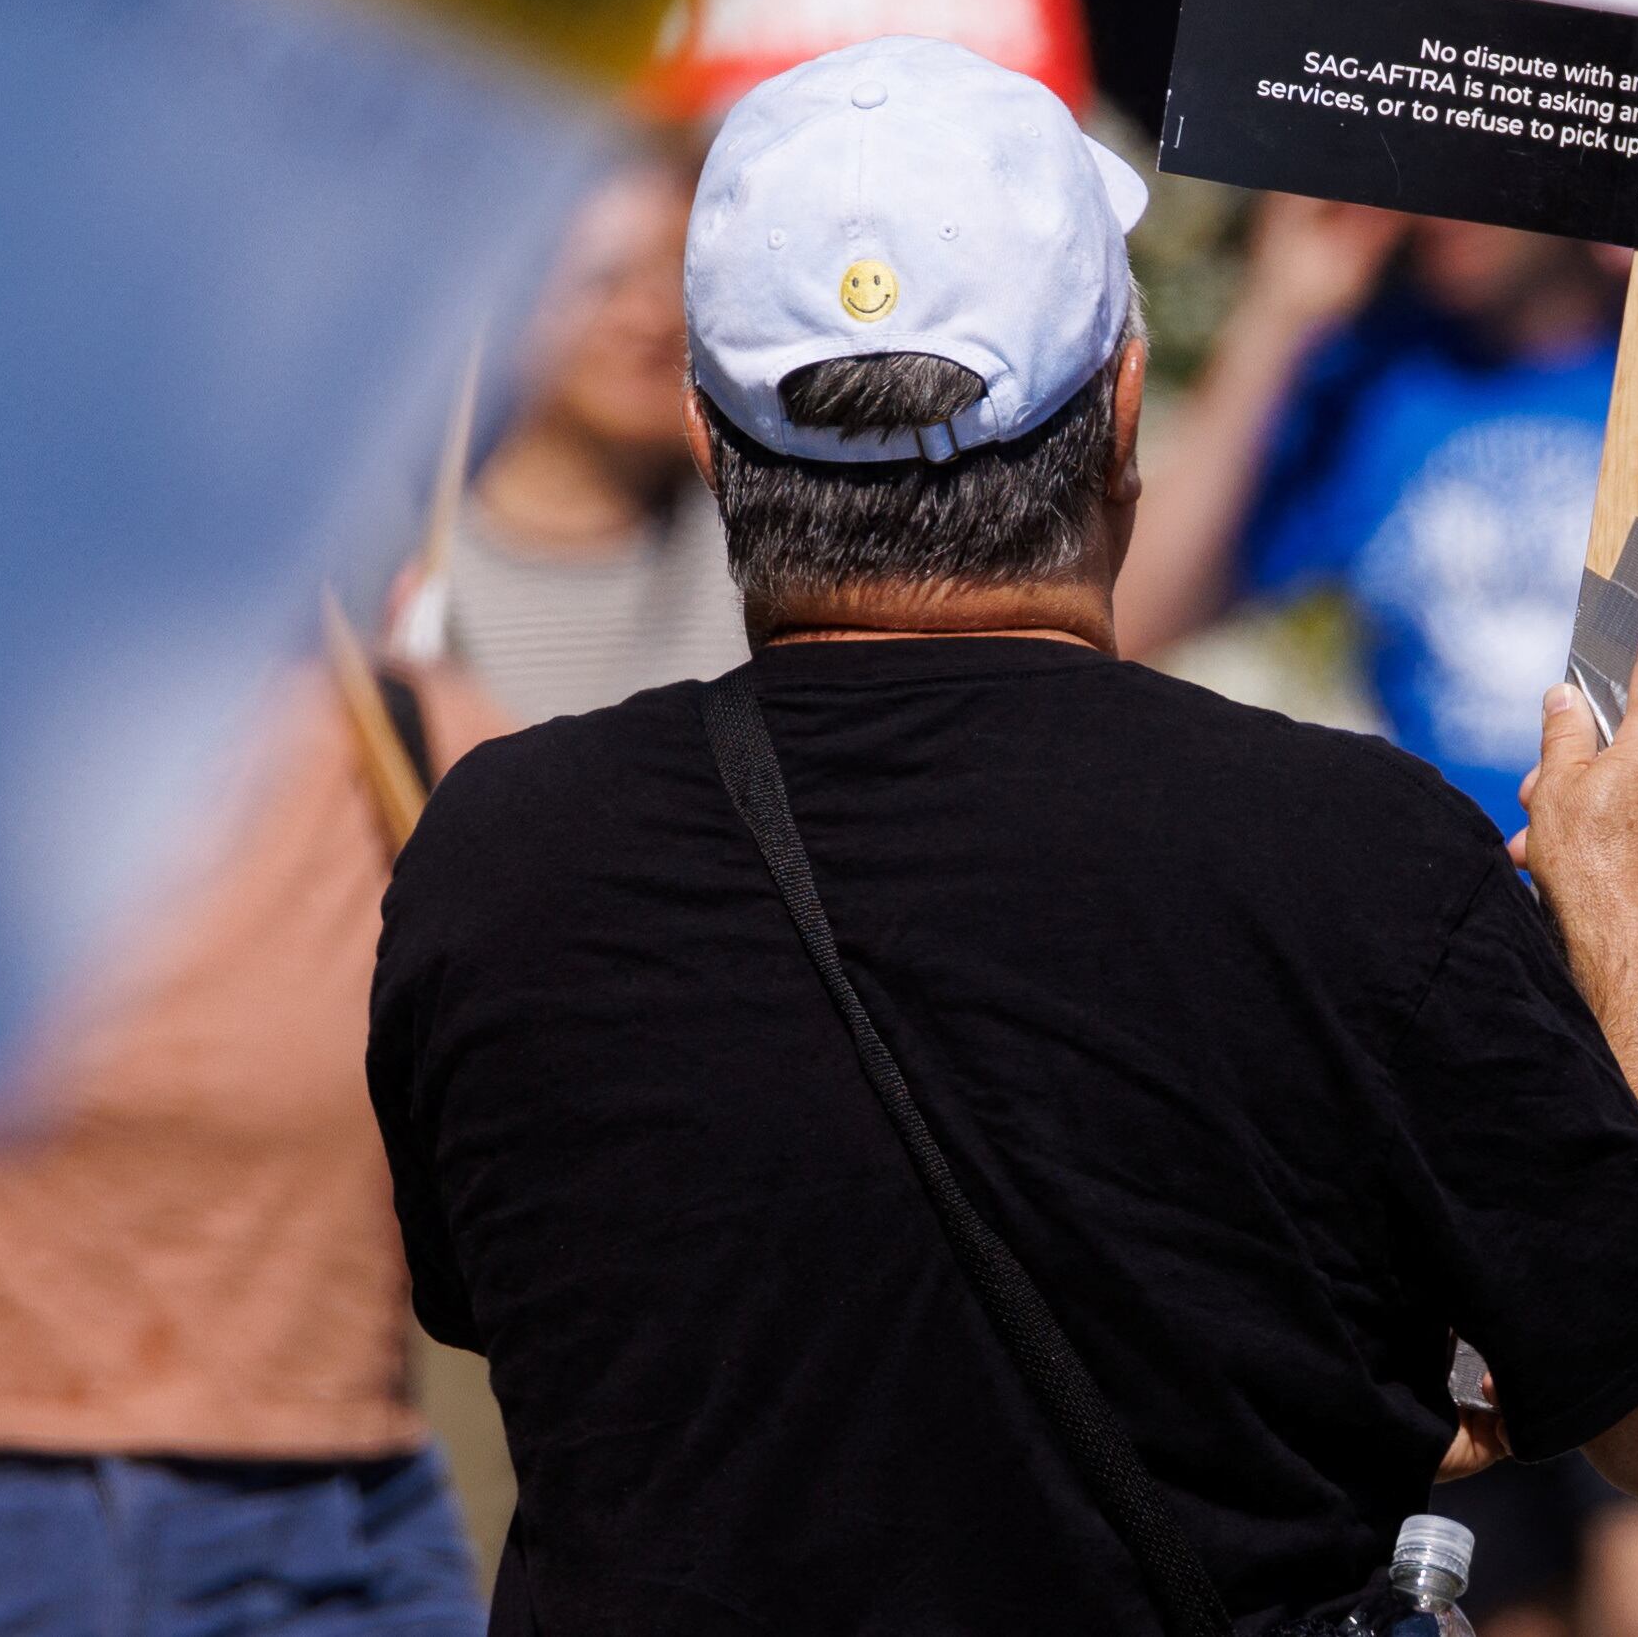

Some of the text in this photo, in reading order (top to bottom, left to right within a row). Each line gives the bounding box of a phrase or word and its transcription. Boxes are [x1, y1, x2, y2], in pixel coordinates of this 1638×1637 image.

[1303, 51, 1457, 95] SAG-AFTRA
[1463, 74, 1484, 99] is
[1490, 84, 1533, 107] not
[1538, 90, 1615, 124] asking
[1420, 37, 1457, 64] No
[1463, 45, 1558, 79] dispute
[1563, 62, 1614, 88] with
[1256, 79, 1369, 116] services,
[1377, 98, 1406, 117] or
[1411, 99, 1439, 123] to
[1445, 106, 1524, 136] refuse
[1530, 118, 1555, 141] to
[1559, 122, 1609, 150] pick
